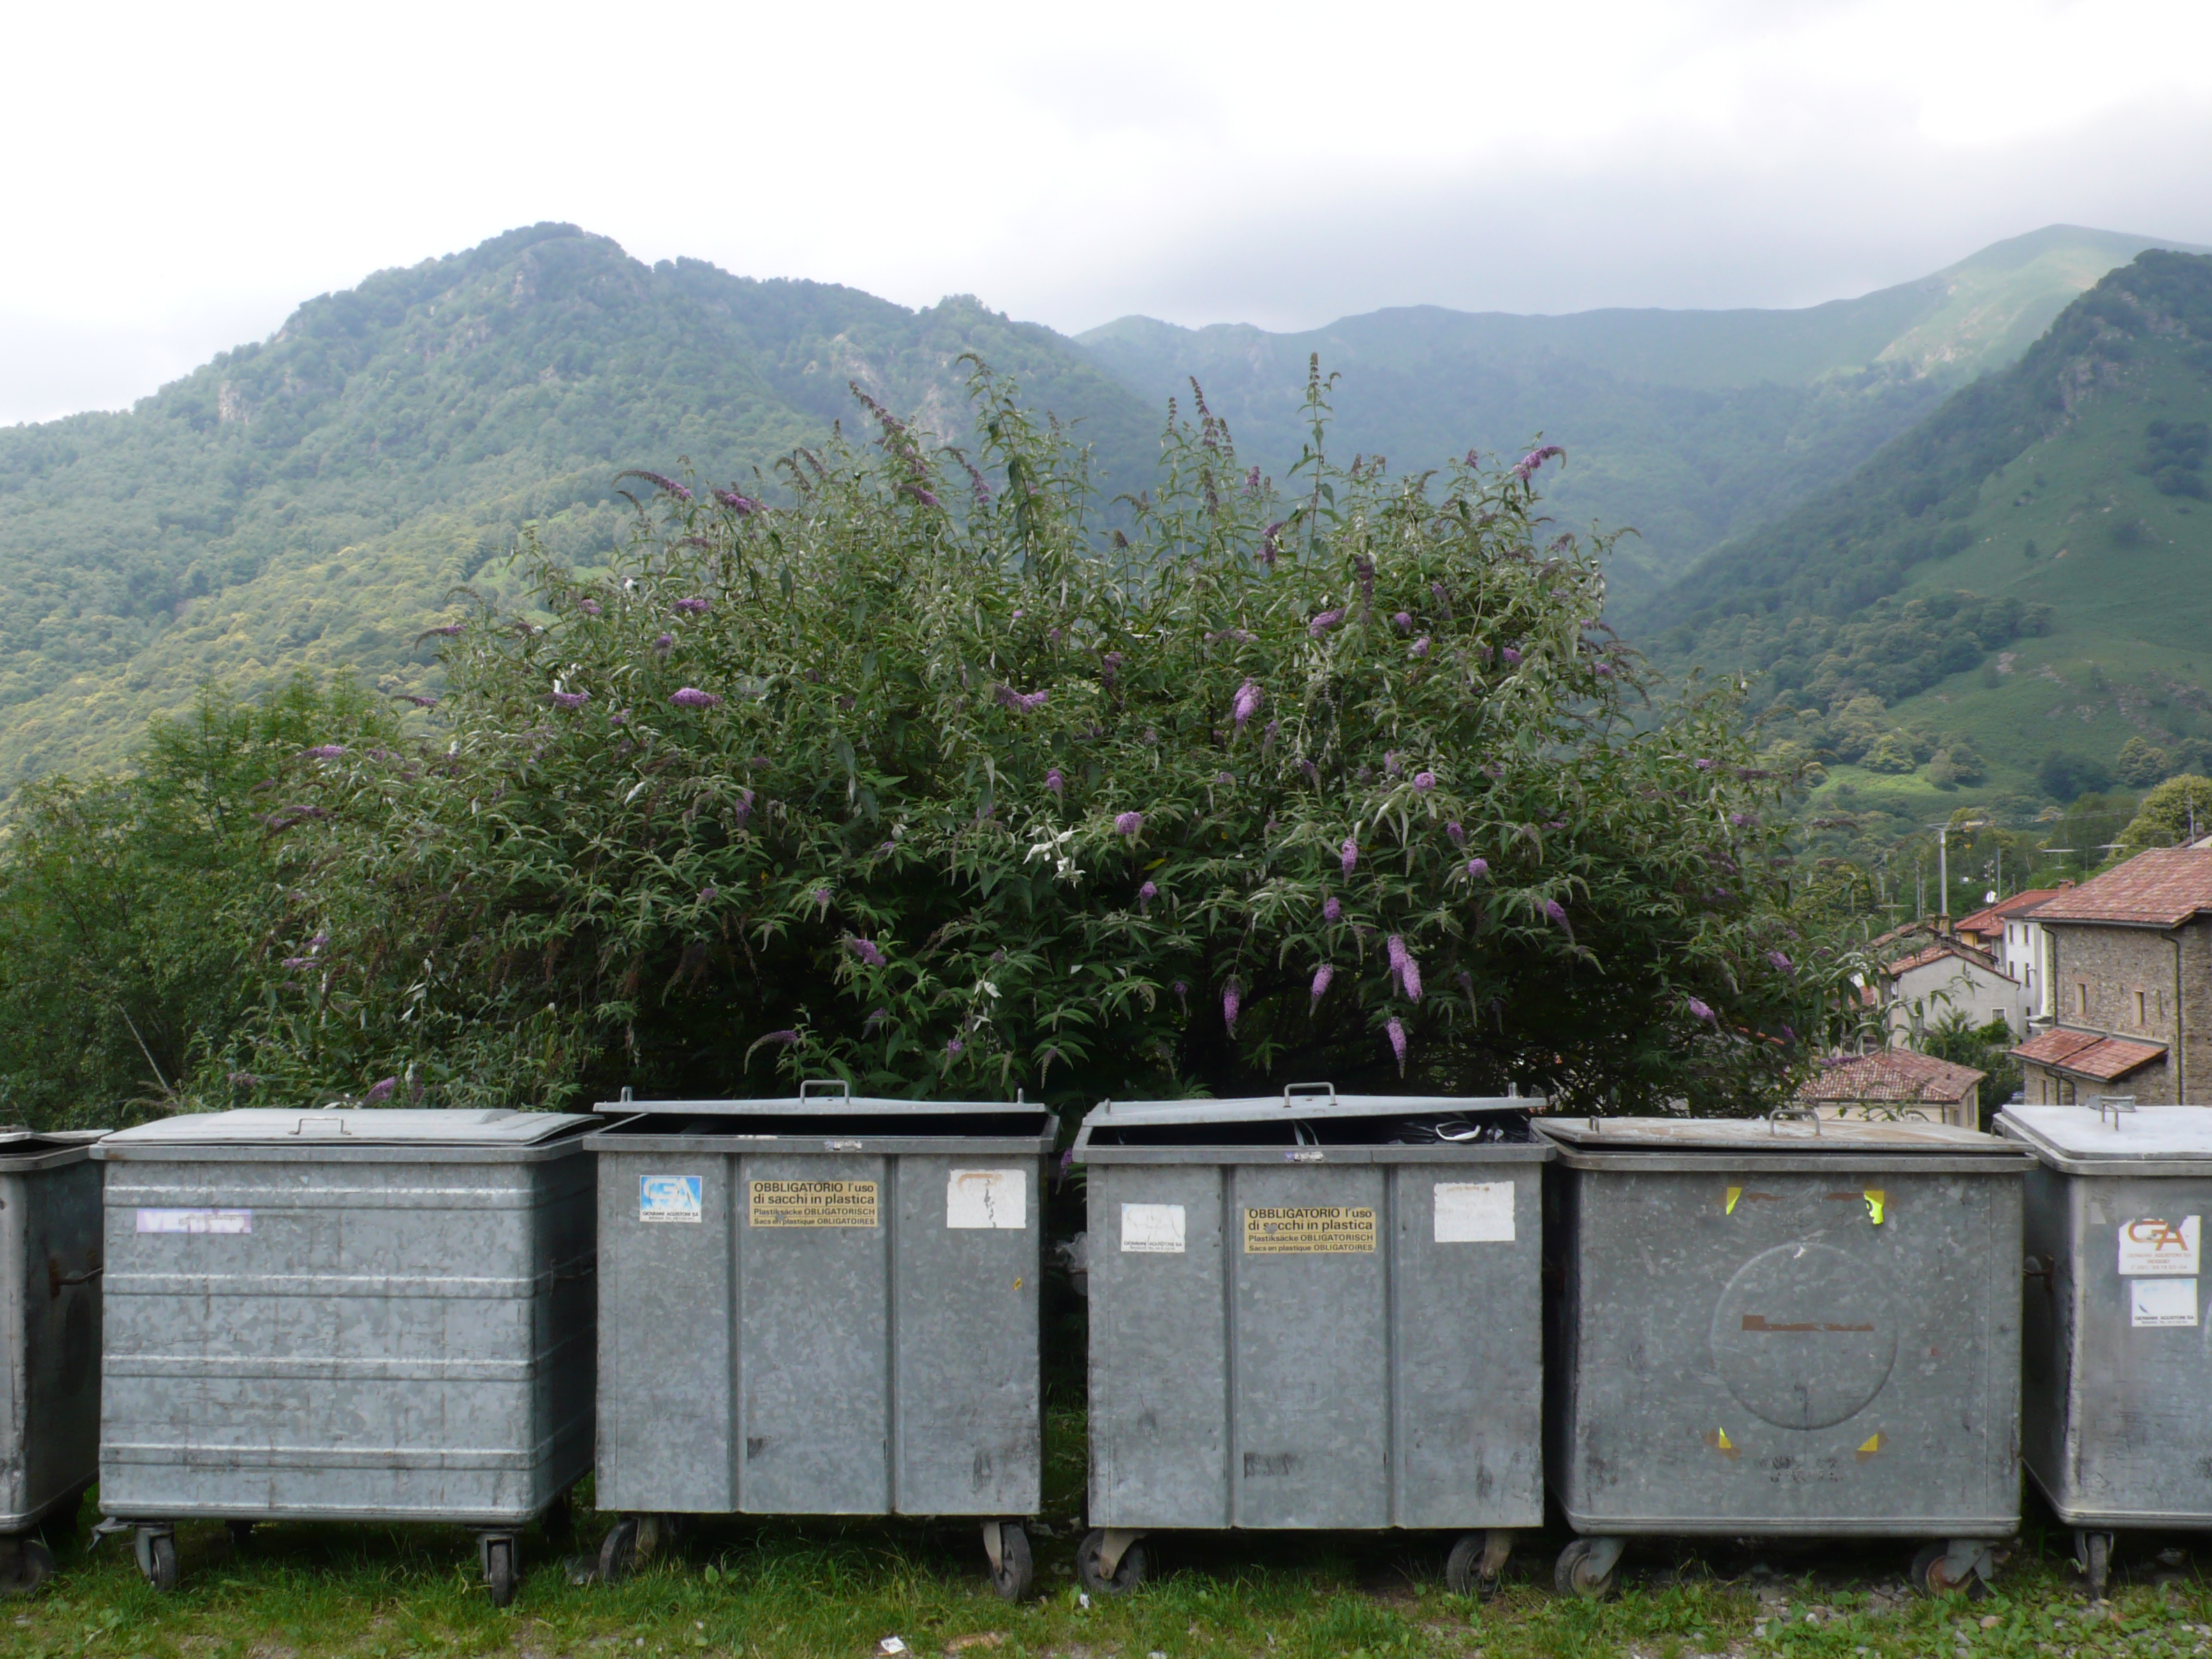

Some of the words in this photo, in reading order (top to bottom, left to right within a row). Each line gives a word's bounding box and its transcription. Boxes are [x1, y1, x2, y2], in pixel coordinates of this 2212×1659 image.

[754, 1182, 843, 1193] OBBLIGATORIO
[753, 1193, 765, 1204] di
[768, 1193, 808, 1204] sacchi
[811, 1193, 822, 1204] in
[825, 1193, 875, 1206] plastica
[1249, 1209, 1340, 1218] OBBLIGATORIO
[783, 1218, 816, 1226] plastique
[1248, 1220, 1260, 1230] di
[1307, 1220, 1318, 1230] in
[1322, 1220, 1373, 1232] plastica
[2128, 1220, 2188, 1251] GA
